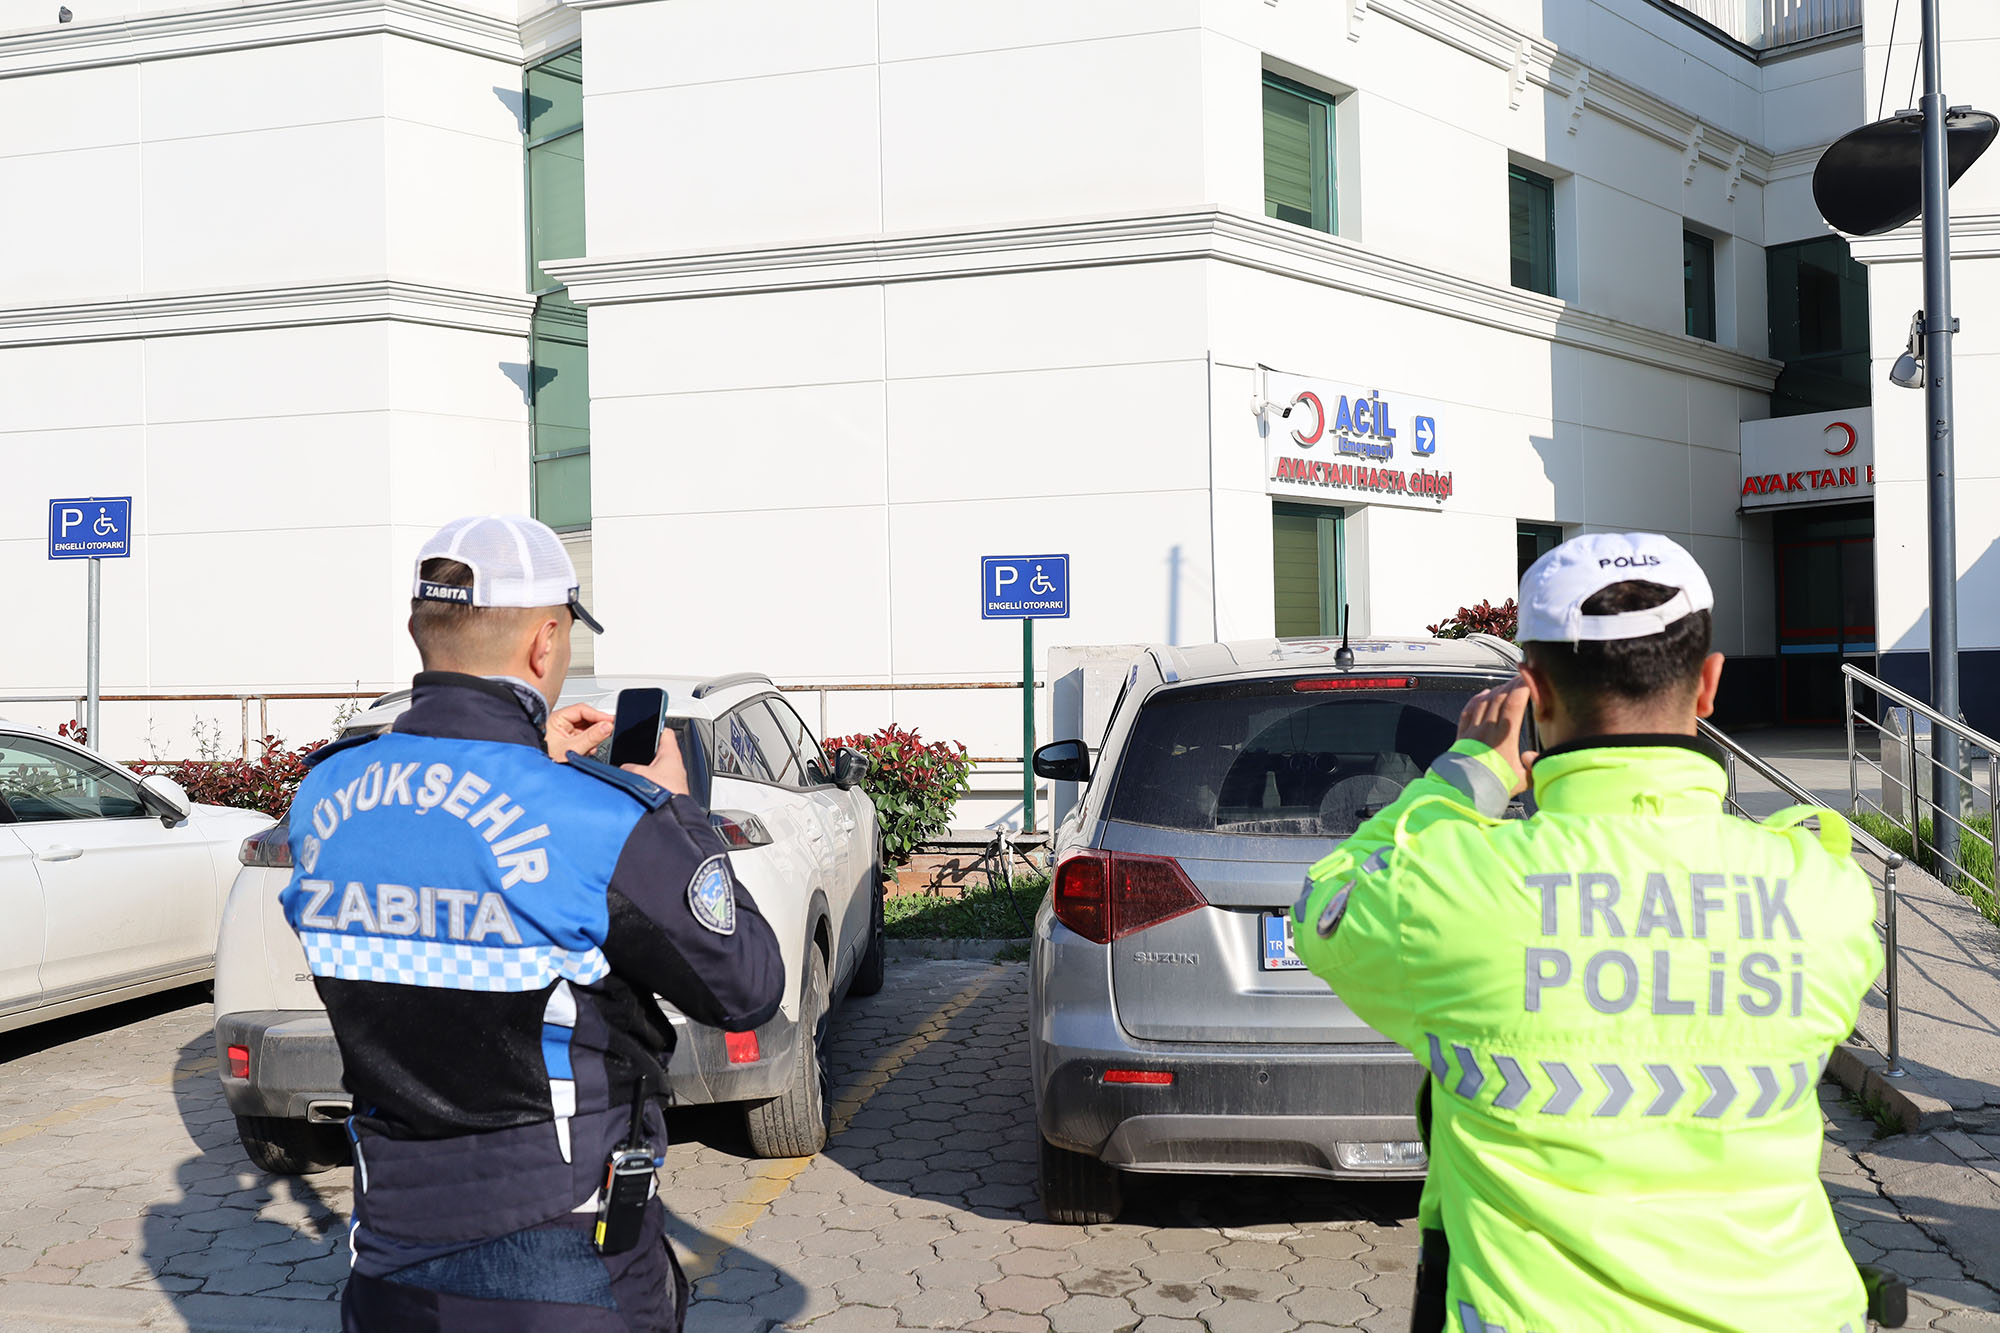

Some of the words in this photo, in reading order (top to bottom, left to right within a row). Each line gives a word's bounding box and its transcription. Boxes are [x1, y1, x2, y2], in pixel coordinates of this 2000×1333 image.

[1335, 390, 1397, 438] ACİL
[1276, 457, 1353, 486] AYAKTAN
[1357, 465, 1407, 492] HASTA
[1410, 468, 1453, 500] GİRİŞİ
[1742, 467, 1856, 495] AYAKTAN
[61, 508, 84, 538] P
[55, 541, 86, 551] ENGELLİ
[86, 541, 124, 549] OTOPARKI
[425, 585, 468, 600] ZABITA
[995, 566, 1019, 597] P
[988, 600, 1022, 610] ENGELLİ
[1023, 601, 1063, 609] OTOPARKI
[300, 879, 523, 945] ZABITA
[1133, 951, 1200, 965] SUZUKI
[1269, 940, 1283, 951] TR
